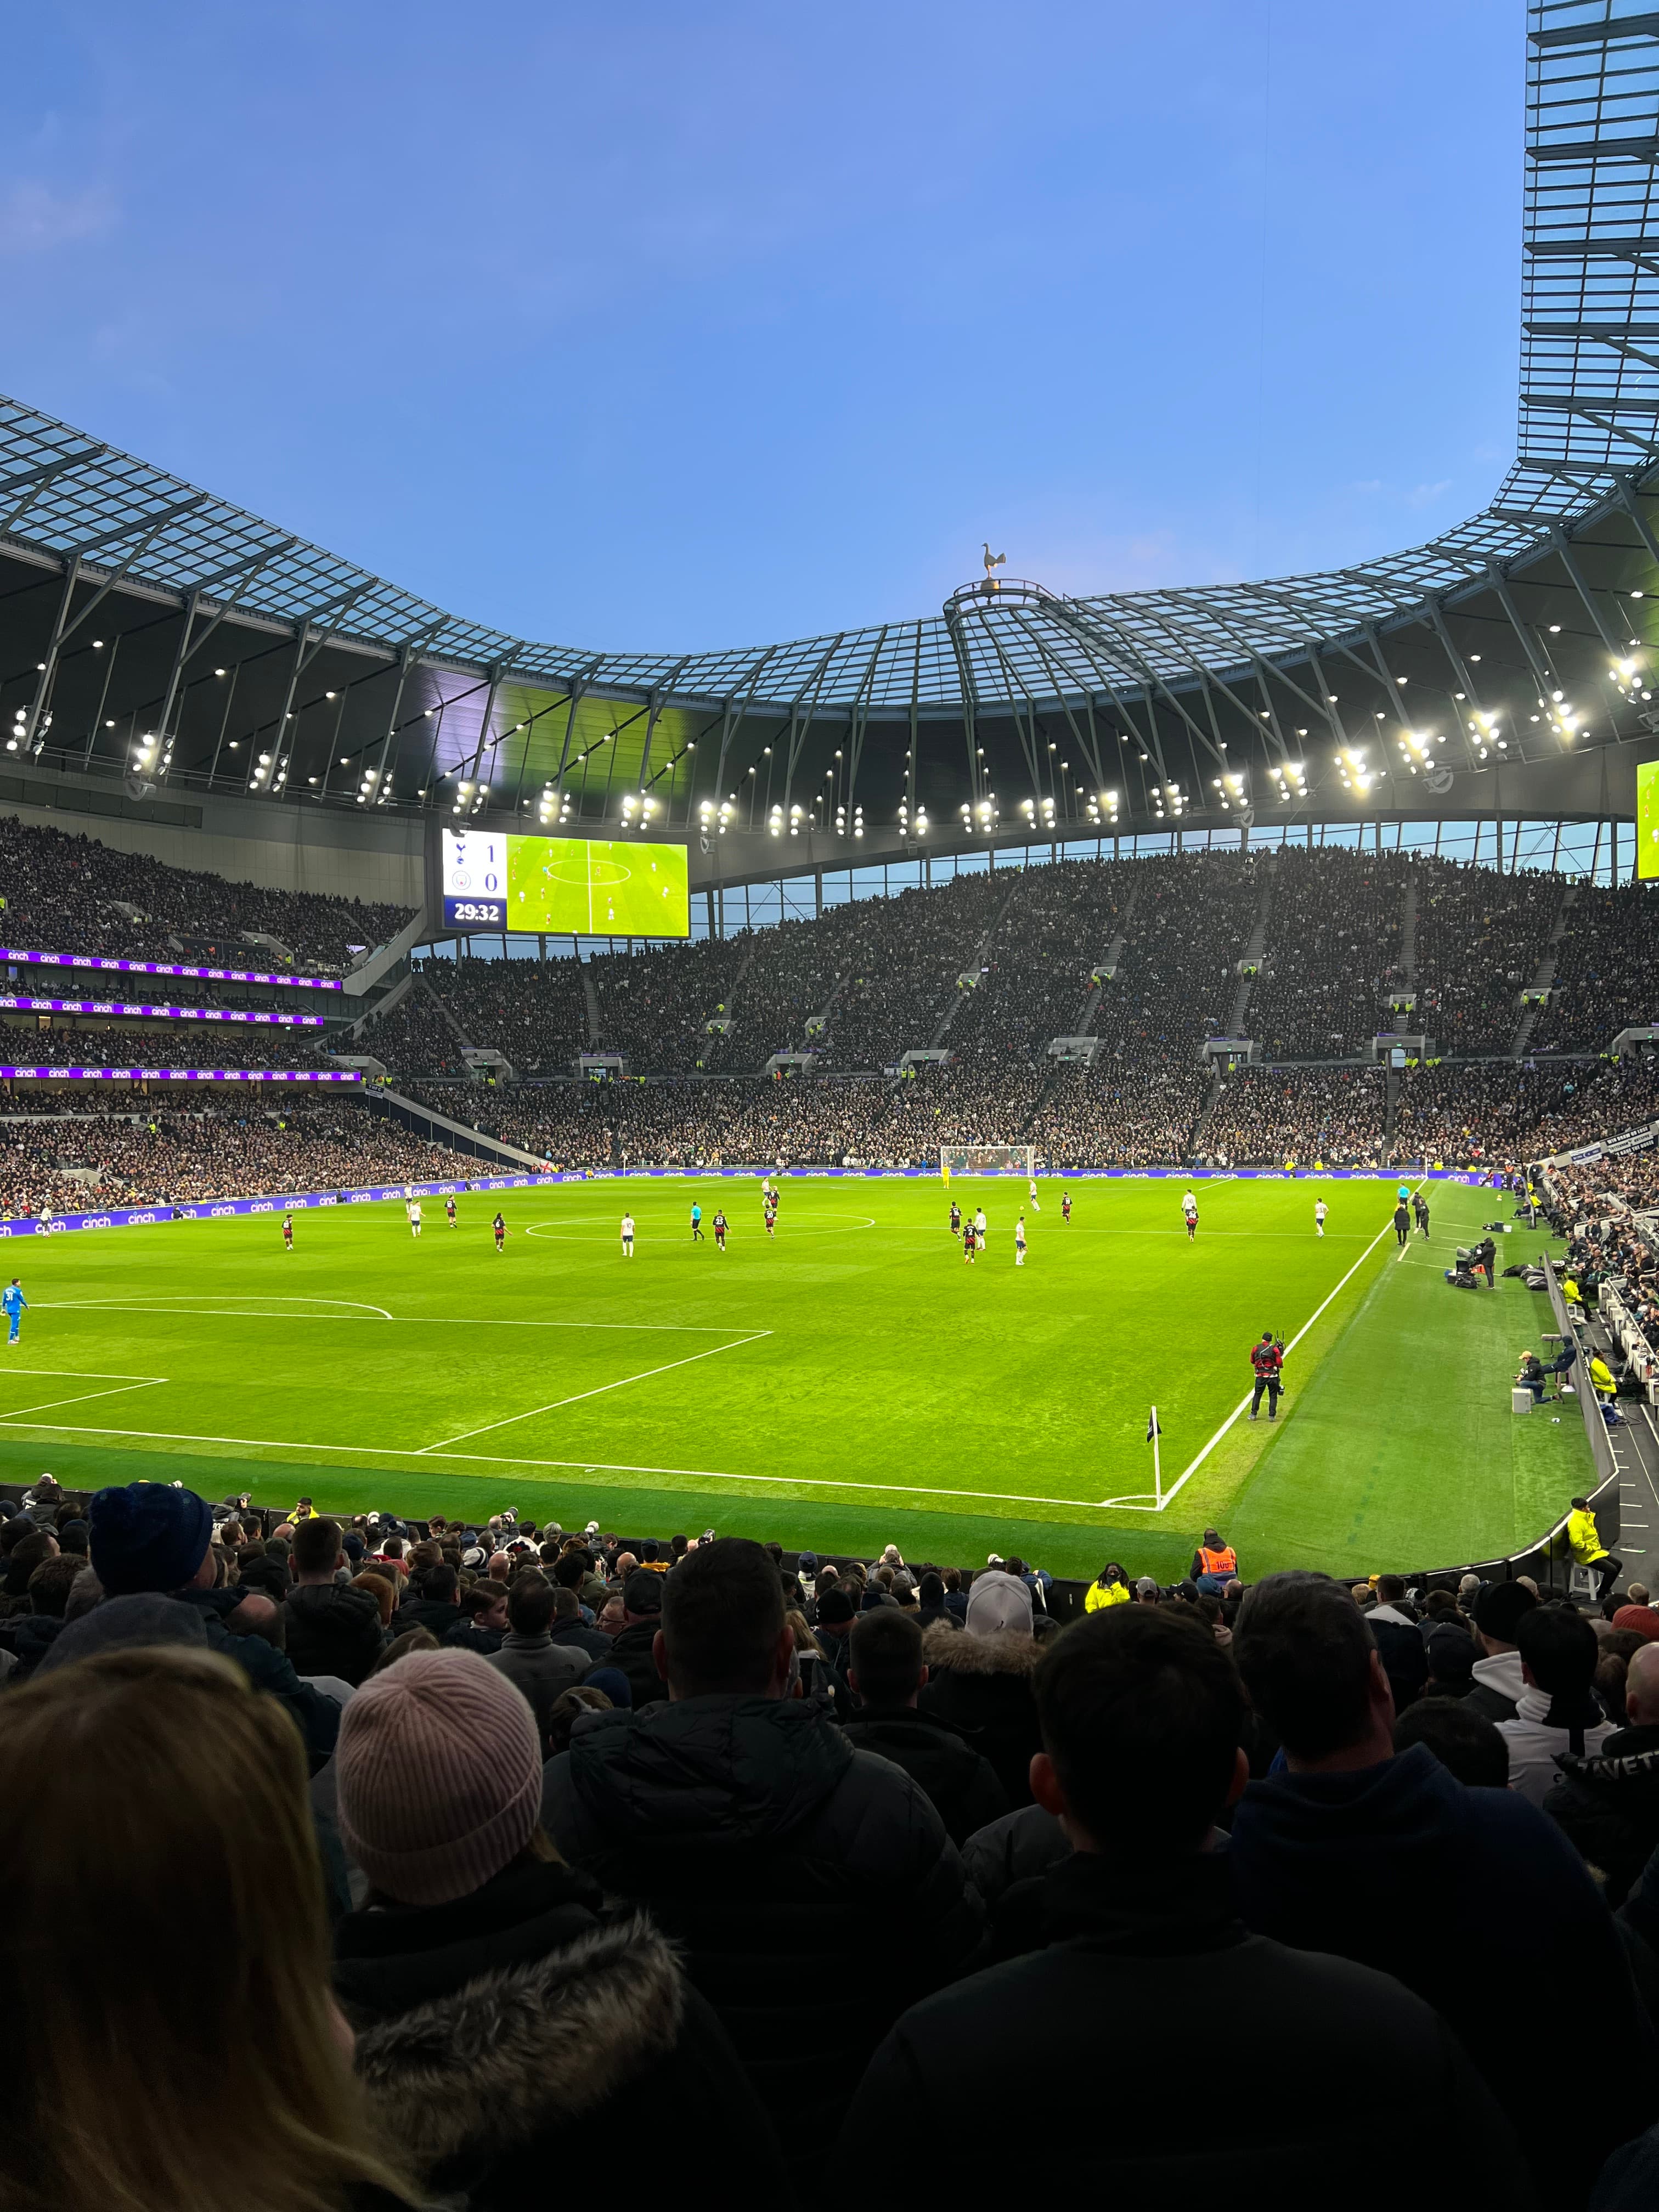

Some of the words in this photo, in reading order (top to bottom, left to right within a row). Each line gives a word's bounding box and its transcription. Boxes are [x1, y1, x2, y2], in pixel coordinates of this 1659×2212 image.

[487, 845, 494, 863] 1
[485, 873, 498, 891] 0
[455, 903, 499, 921] 29:32
[9, 950, 28, 960] cinch
[41, 952, 59, 963] cinch
[73, 955, 91, 966] cinch
[101, 957, 119, 968] cinch
[129, 961, 146, 970] cinch
[156, 963, 172, 973] cinch
[183, 965, 198, 975] cinch
[208, 968, 223, 978] cinch
[232, 970, 246, 980] cinch
[255, 972, 269, 982] cinch
[277, 975, 291, 984] cinch
[299, 977, 312, 986] cinch
[321, 979, 334, 988] cinch
[32, 999, 52, 1009] cinch
[63, 1001, 81, 1011] cinch
[93, 1003, 112, 1012] cinch
[124, 1005, 141, 1014] cinch
[152, 1006, 169, 1015] cinch
[180, 1008, 197, 1017] cinch
[206, 1009, 221, 1019] cinch
[231, 1011, 246, 1020] cinch
[255, 1012, 270, 1021] cinch
[279, 1014, 293, 1023] cinch
[303, 1015, 316, 1024] cinch
[15, 1067, 36, 1077] cinch
[49, 1068, 69, 1077] cinch
[83, 1068, 101, 1077] cinch
[112, 1069, 130, 1078] cinch
[142, 1069, 159, 1078] cinch
[170, 1069, 187, 1079] cinch
[198, 1070, 213, 1079] cinch
[224, 1070, 240, 1079] cinch
[248, 1071, 263, 1079] cinch
[272, 1071, 287, 1080] cinch
[296, 1071, 309, 1080] cinch
[514, 1177, 528, 1187] cinch
[537, 1175, 553, 1184] cinch
[563, 1173, 582, 1182] cinch
[439, 1184, 455, 1194] cinch
[489, 1180, 505, 1189] cinch
[351, 1192, 371, 1203] cinch
[382, 1189, 400, 1199] cinch
[251, 1200, 273, 1212] cinch
[285, 1197, 307, 1209] cinch
[211, 1204, 235, 1216] cinch
[82, 1215, 111, 1229] cinch
[128, 1211, 155, 1224] cinch
[5, 1291, 13, 1301] 31
